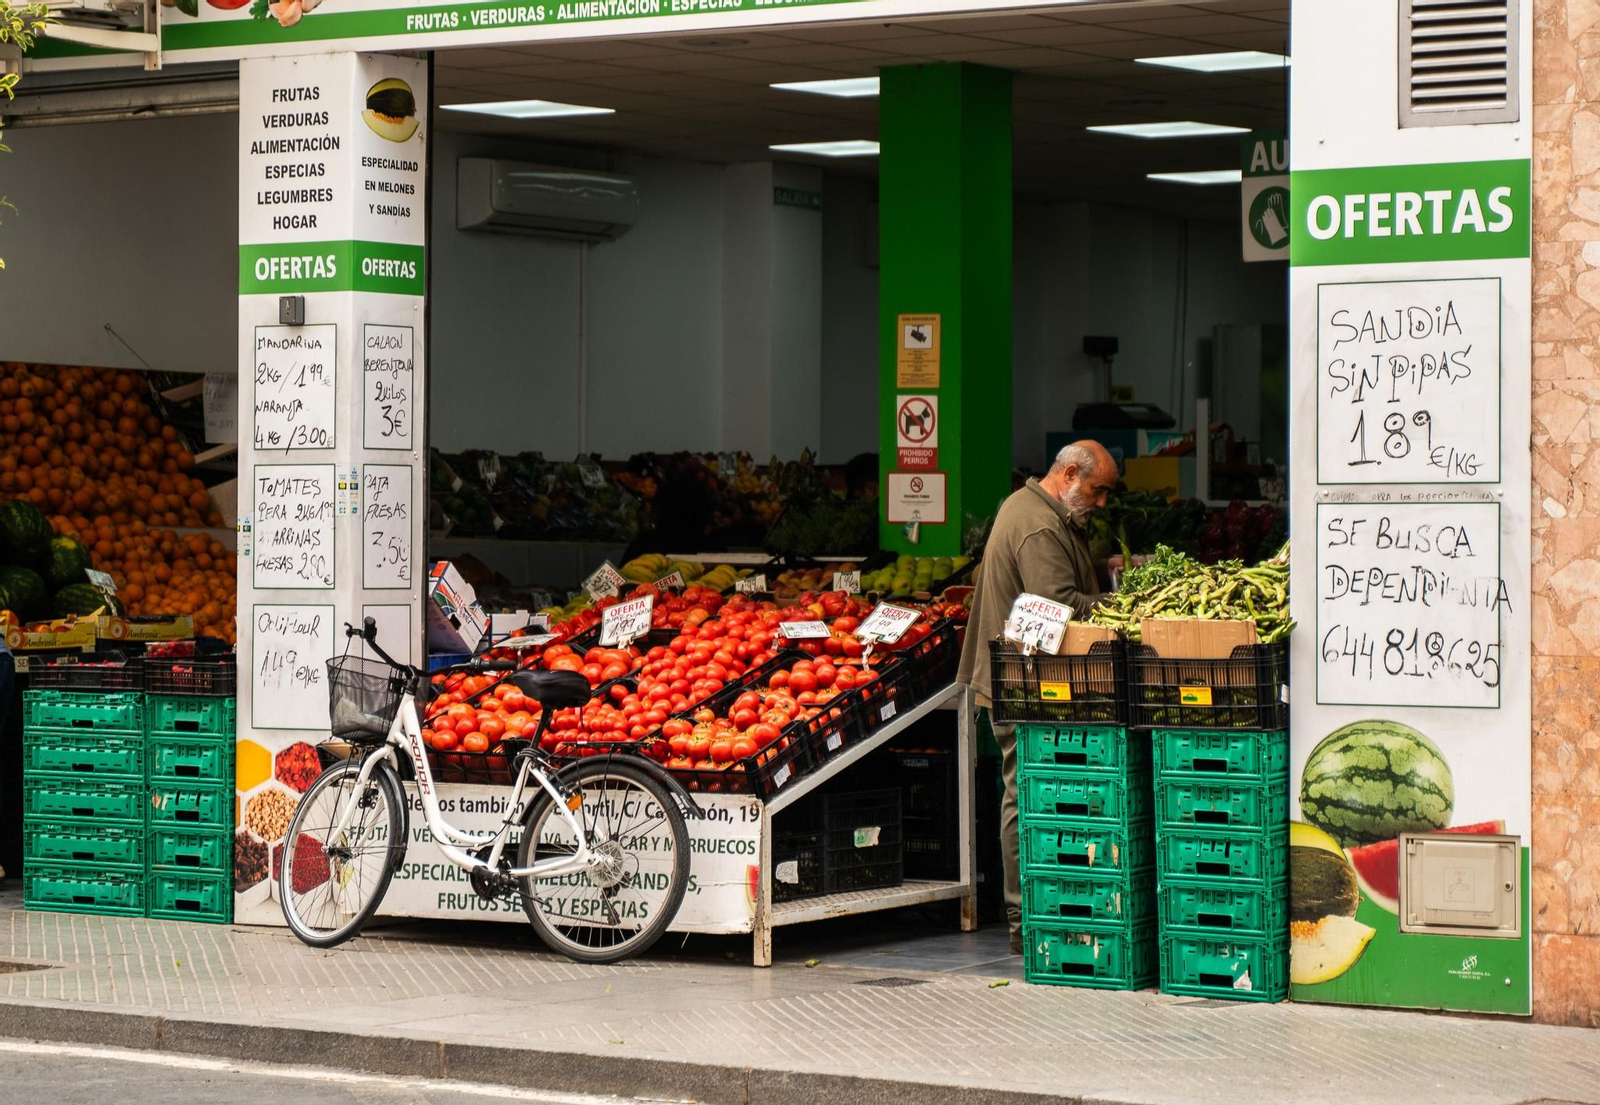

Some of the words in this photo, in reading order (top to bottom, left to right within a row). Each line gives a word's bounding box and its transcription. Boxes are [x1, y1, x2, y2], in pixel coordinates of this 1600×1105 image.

[406, 12, 459, 30] FRUTAS
[470, 5, 545, 26] VERDURAS
[272, 87, 320, 103] FRUTAS
[262, 111, 329, 129] VERDURAS
[250, 134, 340, 155] ALIMENTACIÓN
[265, 162, 325, 180] ESPECIAS
[361, 156, 418, 173] ESPECIALIDAD
[257, 187, 333, 206] LEGUMBRES
[364, 180, 376, 192] EN
[378, 181, 415, 195] MELONES
[368, 204, 374, 214] Y
[376, 203, 411, 218] SANDÍAS
[1306, 186, 1514, 240] OFERTAS
[273, 214, 317, 230] HOGAR
[255, 254, 336, 281] OFERTAS
[361, 257, 416, 279] OFERTAS
[254, 399, 303, 421] NARANJA
[899, 450, 933, 458] PROHIBIDO
[903, 457, 929, 465] PERROS
[258, 501, 287, 523] PERA
[364, 501, 407, 523] FRESAS
[1376, 517, 1477, 558] BUSCA
[610, 600, 645, 618] OFERTA
[881, 606, 912, 620] OFERTA
[1023, 600, 1063, 619] OFERTA
[739, 804, 760, 823] 19
[651, 836, 661, 851] Y
[664, 836, 756, 855] MRRUECOS
[437, 892, 499, 912] FRUTOS
[553, 898, 567, 914] Y
[570, 898, 649, 919] ESPECIAS
